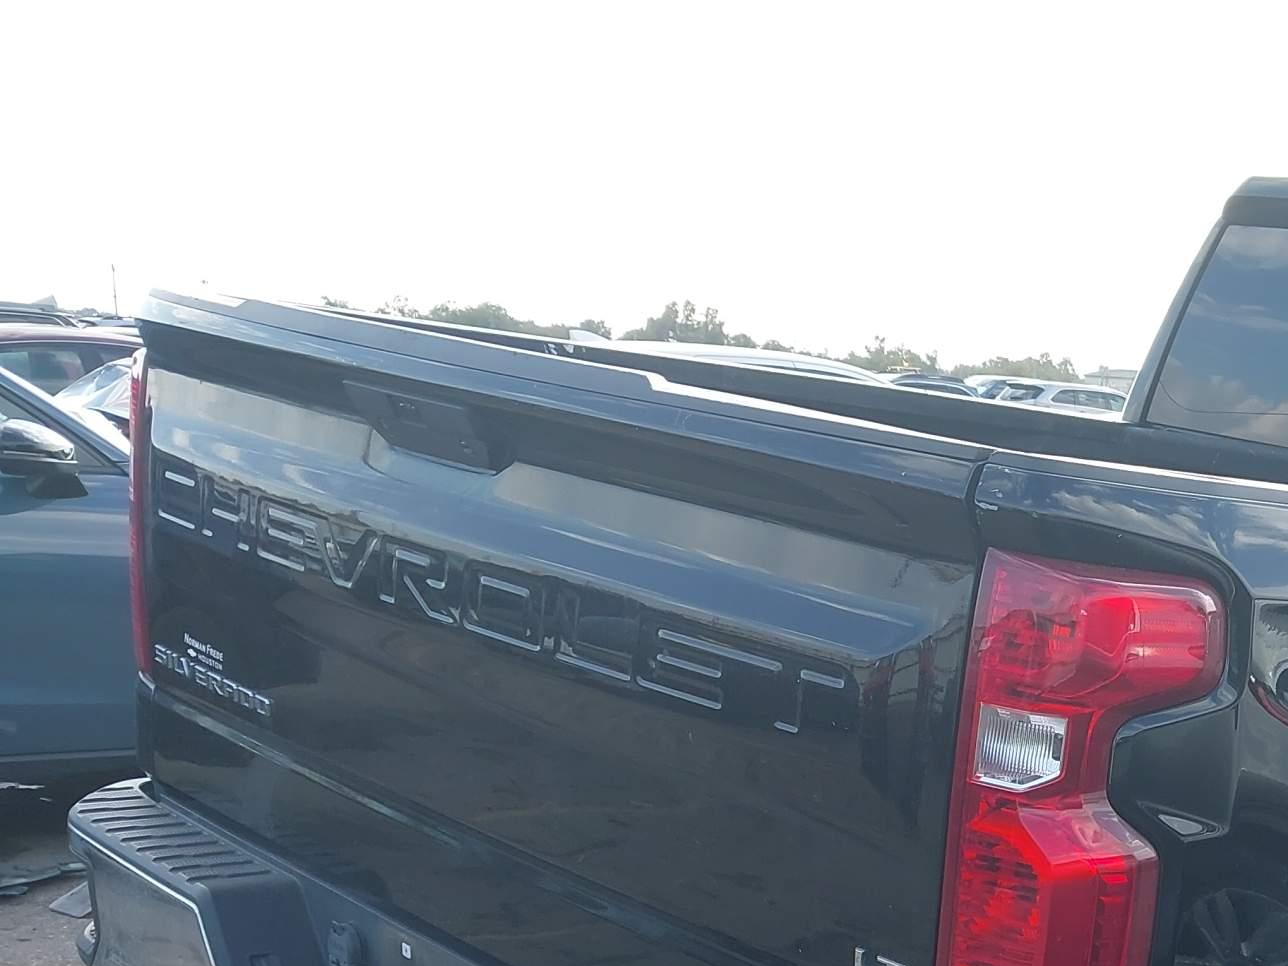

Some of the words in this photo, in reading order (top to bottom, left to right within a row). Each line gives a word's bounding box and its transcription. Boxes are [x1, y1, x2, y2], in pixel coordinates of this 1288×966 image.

[155, 464, 852, 735] CHEVROLET
[183, 632, 206, 653] NORMAN
[197, 653, 223, 671] HOUSTON
[153, 643, 273, 717] SILVERADO
